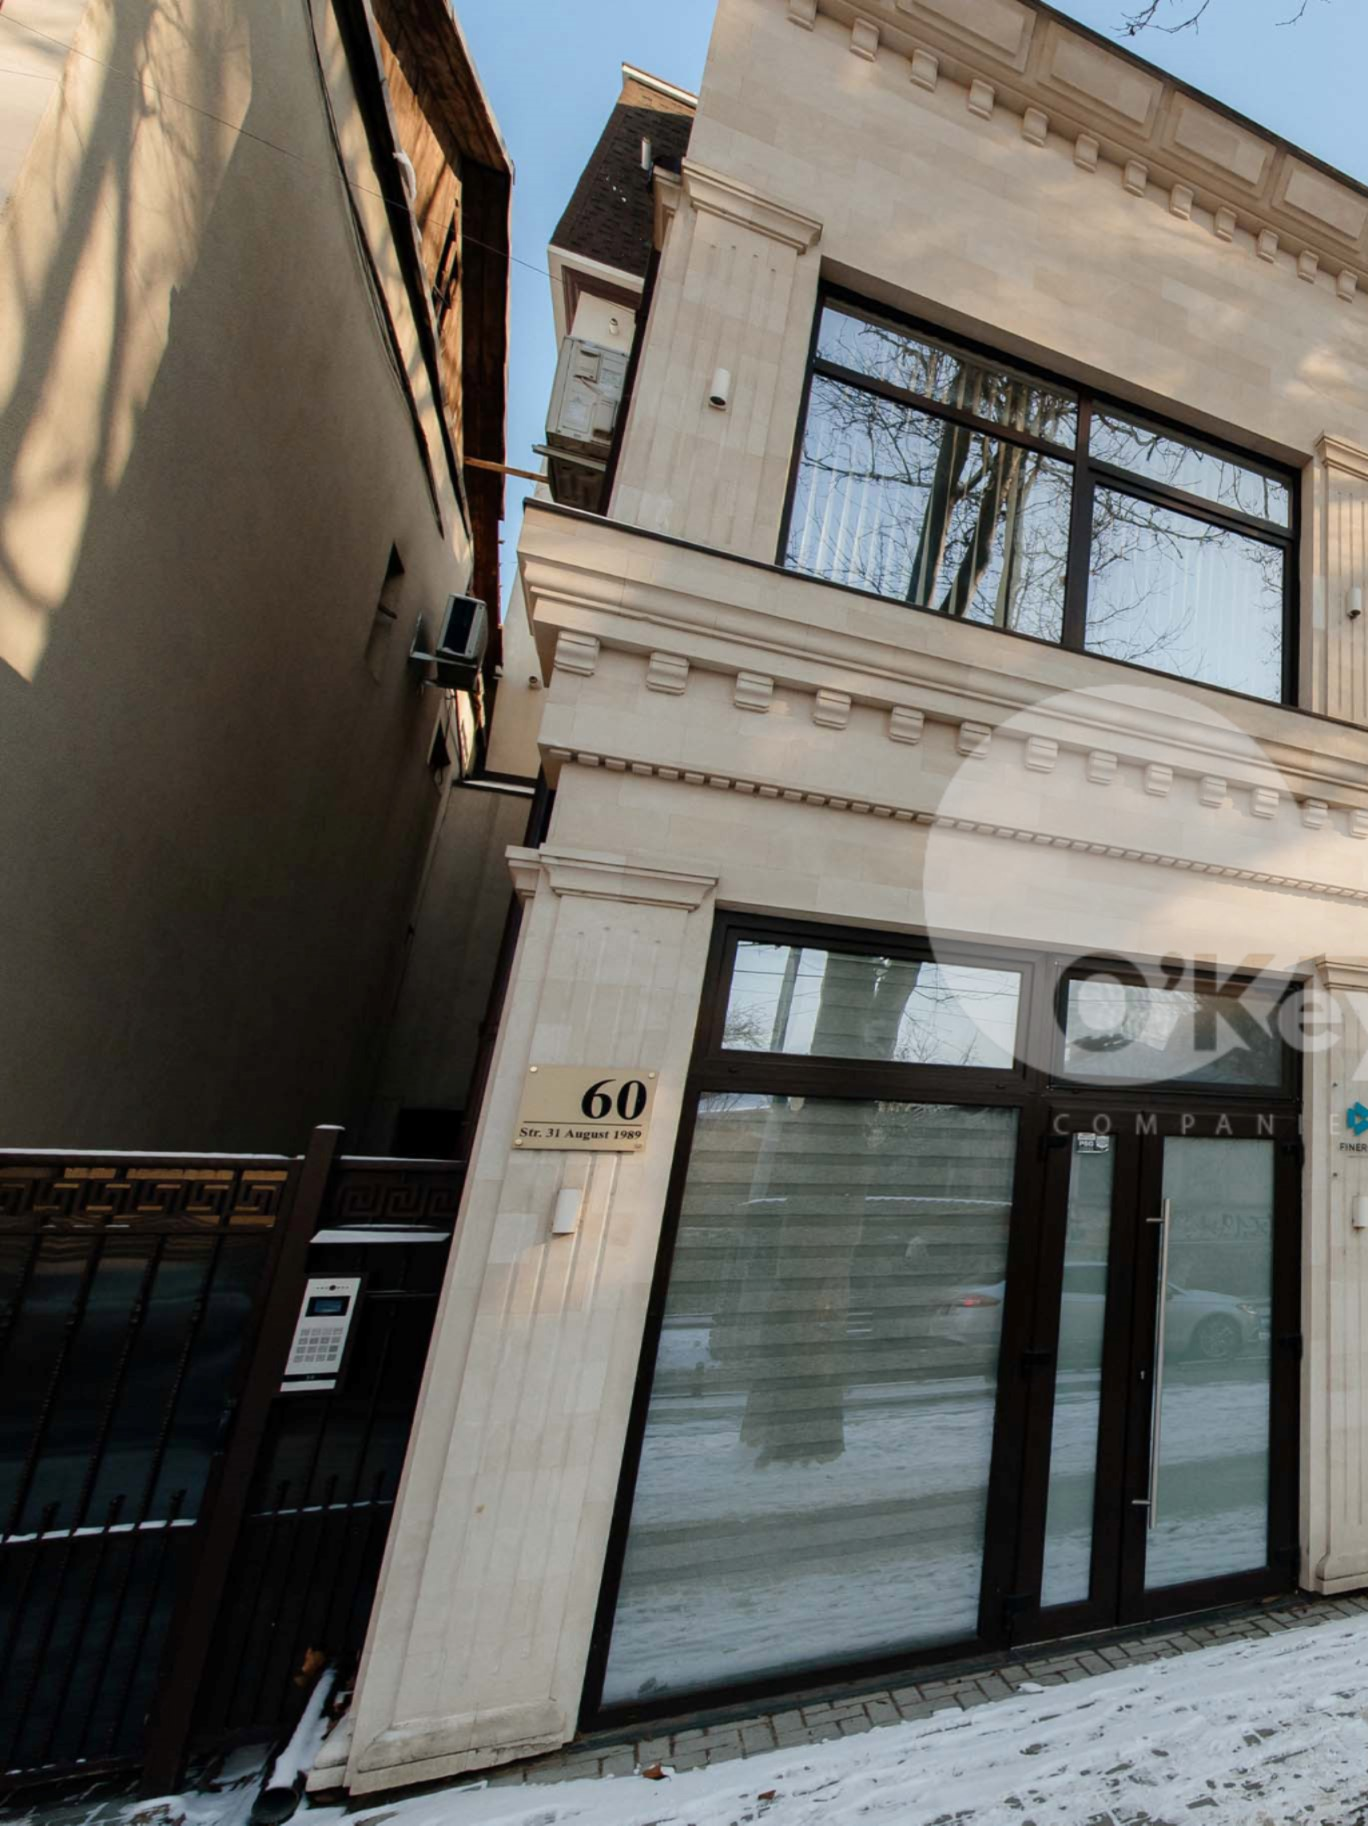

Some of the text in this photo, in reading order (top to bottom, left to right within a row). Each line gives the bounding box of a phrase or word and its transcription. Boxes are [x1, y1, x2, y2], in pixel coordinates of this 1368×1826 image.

[581, 1078, 647, 1120] 60
[519, 1127, 642, 1141] Str. 31 August 1989
